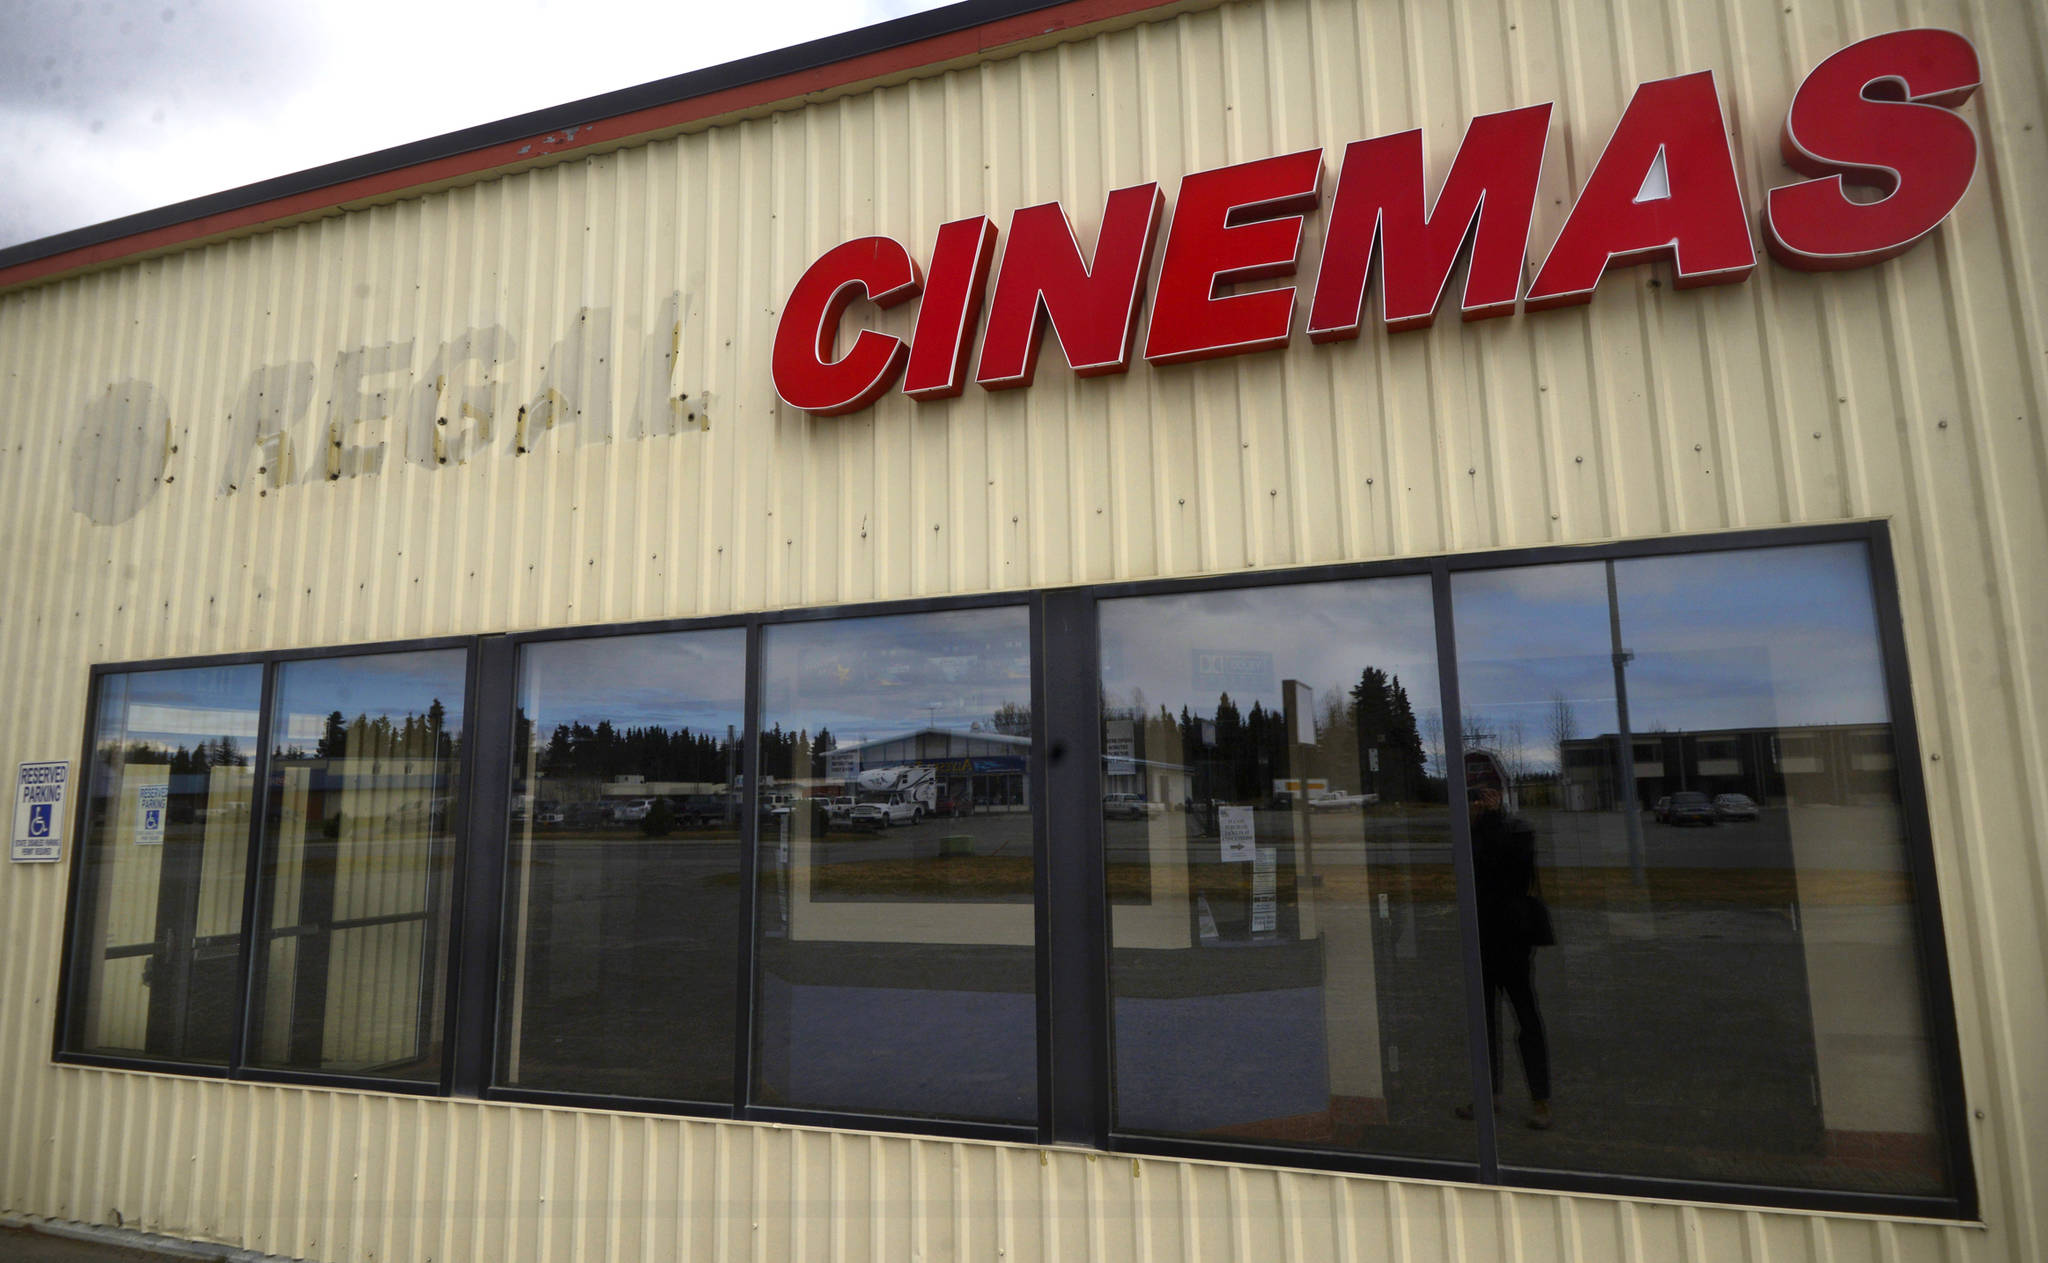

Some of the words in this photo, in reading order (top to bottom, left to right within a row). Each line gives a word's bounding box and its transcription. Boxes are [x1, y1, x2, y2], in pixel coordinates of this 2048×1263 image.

[214, 290, 716, 500] REGAL
[771, 28, 1984, 416] CINEMAS
[21, 766, 65, 784] RESERVED
[23, 785, 61, 803] PARKING
